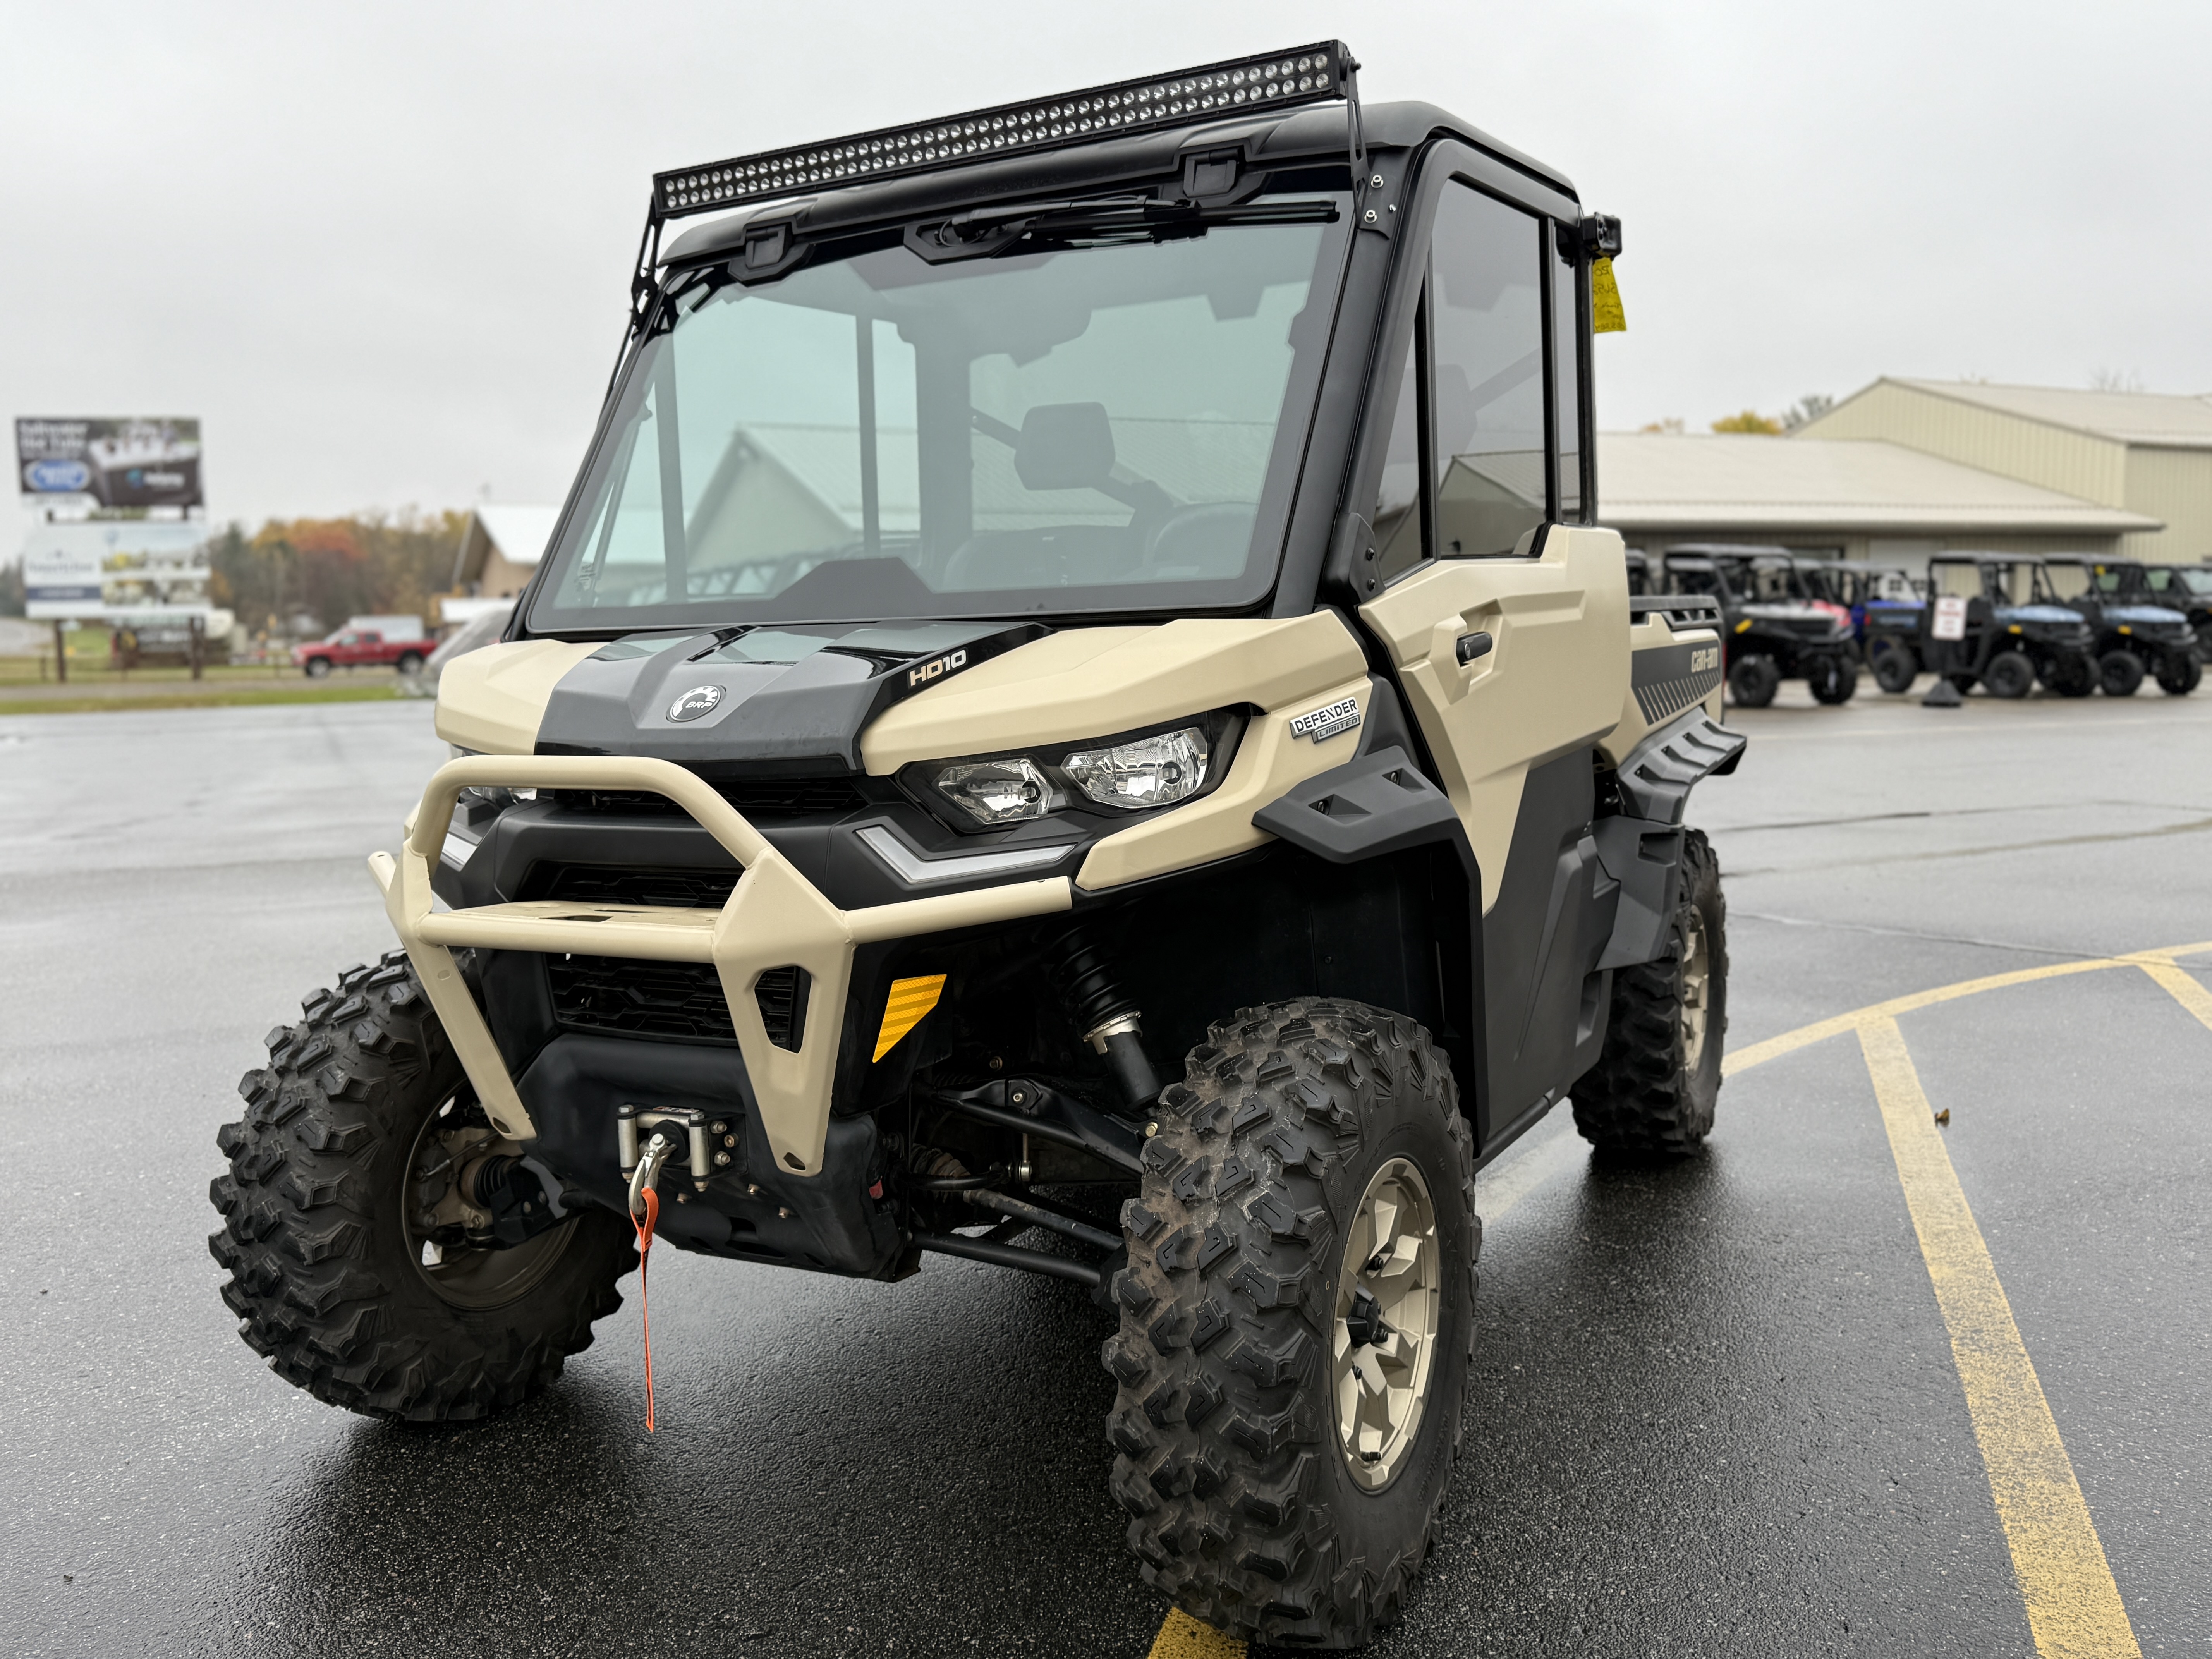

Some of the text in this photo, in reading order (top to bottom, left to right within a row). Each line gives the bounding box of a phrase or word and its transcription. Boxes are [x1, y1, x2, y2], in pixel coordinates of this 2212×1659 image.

[910, 650, 966, 686] HD10
[1295, 699, 1357, 732] DEFENDER
[1319, 718, 1357, 737] LIMITED
